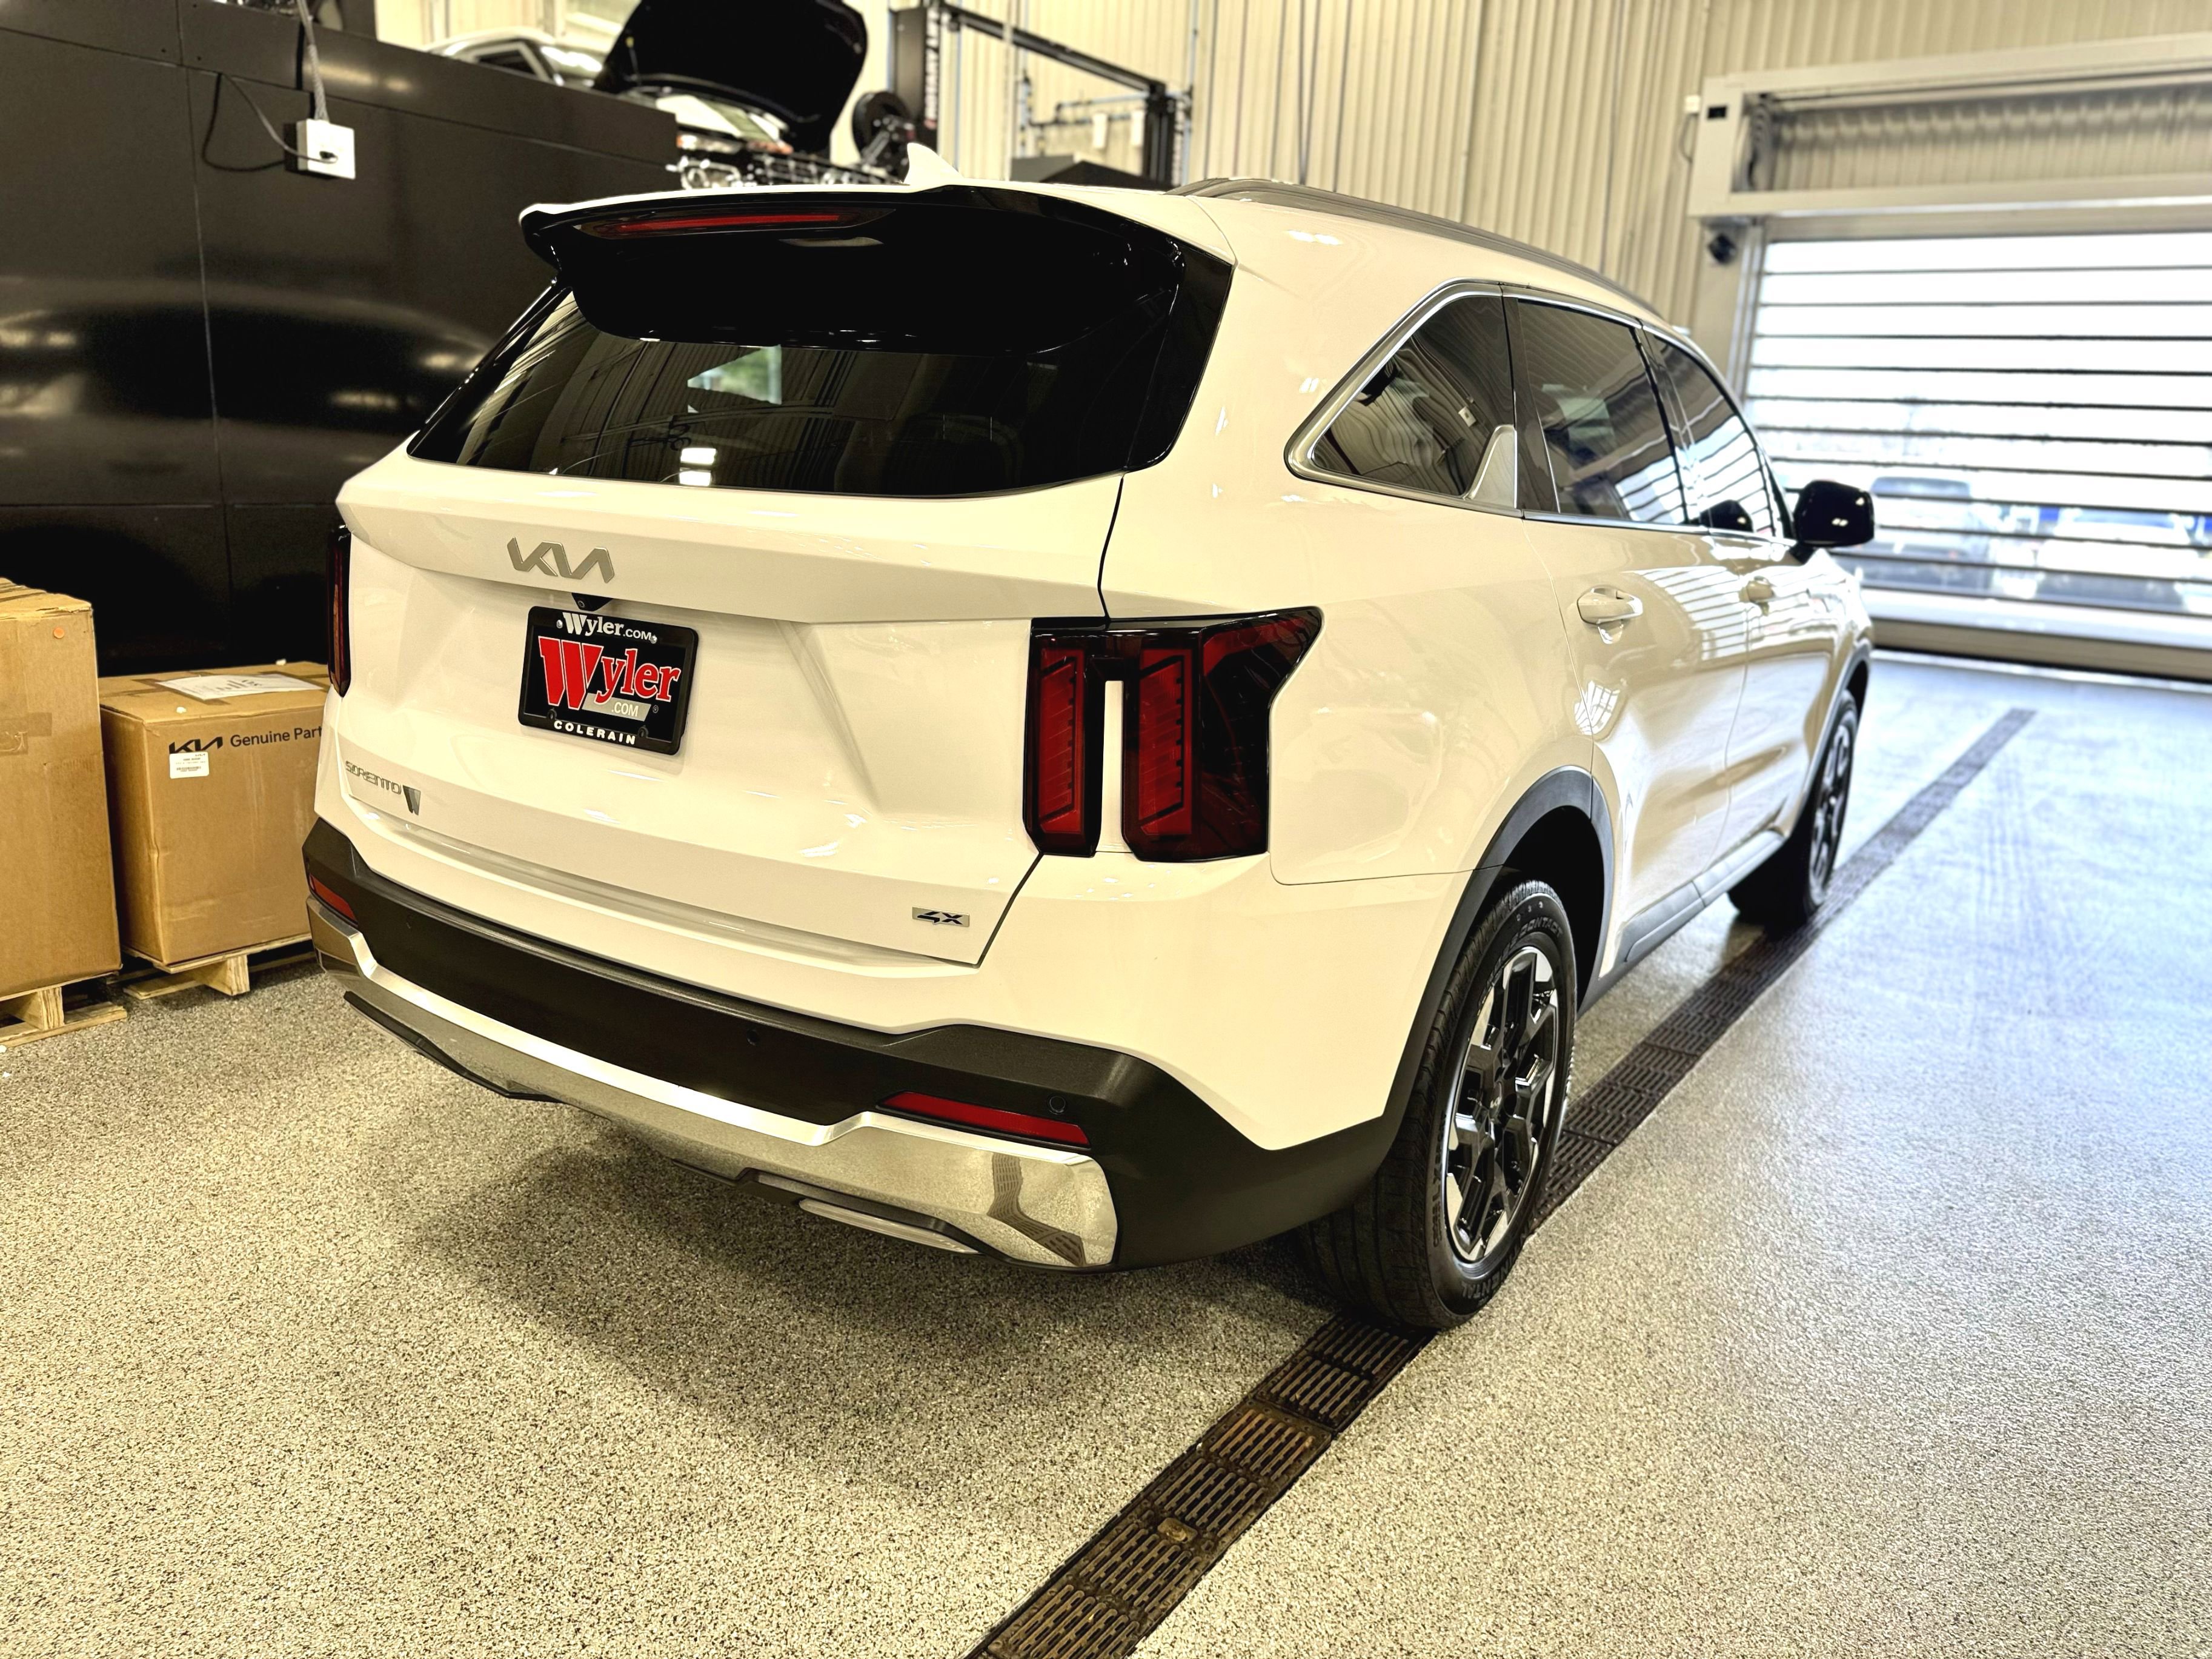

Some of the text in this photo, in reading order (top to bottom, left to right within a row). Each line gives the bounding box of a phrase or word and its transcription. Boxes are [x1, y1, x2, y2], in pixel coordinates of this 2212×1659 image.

[507, 537, 614, 583] KIA
[538, 636, 682, 711] Wyler
[611, 702, 639, 717] .COM
[169, 725, 322, 754] KIA Genuine Part
[554, 720, 636, 745] COLERAIN
[345, 760, 402, 795] SORENTO
